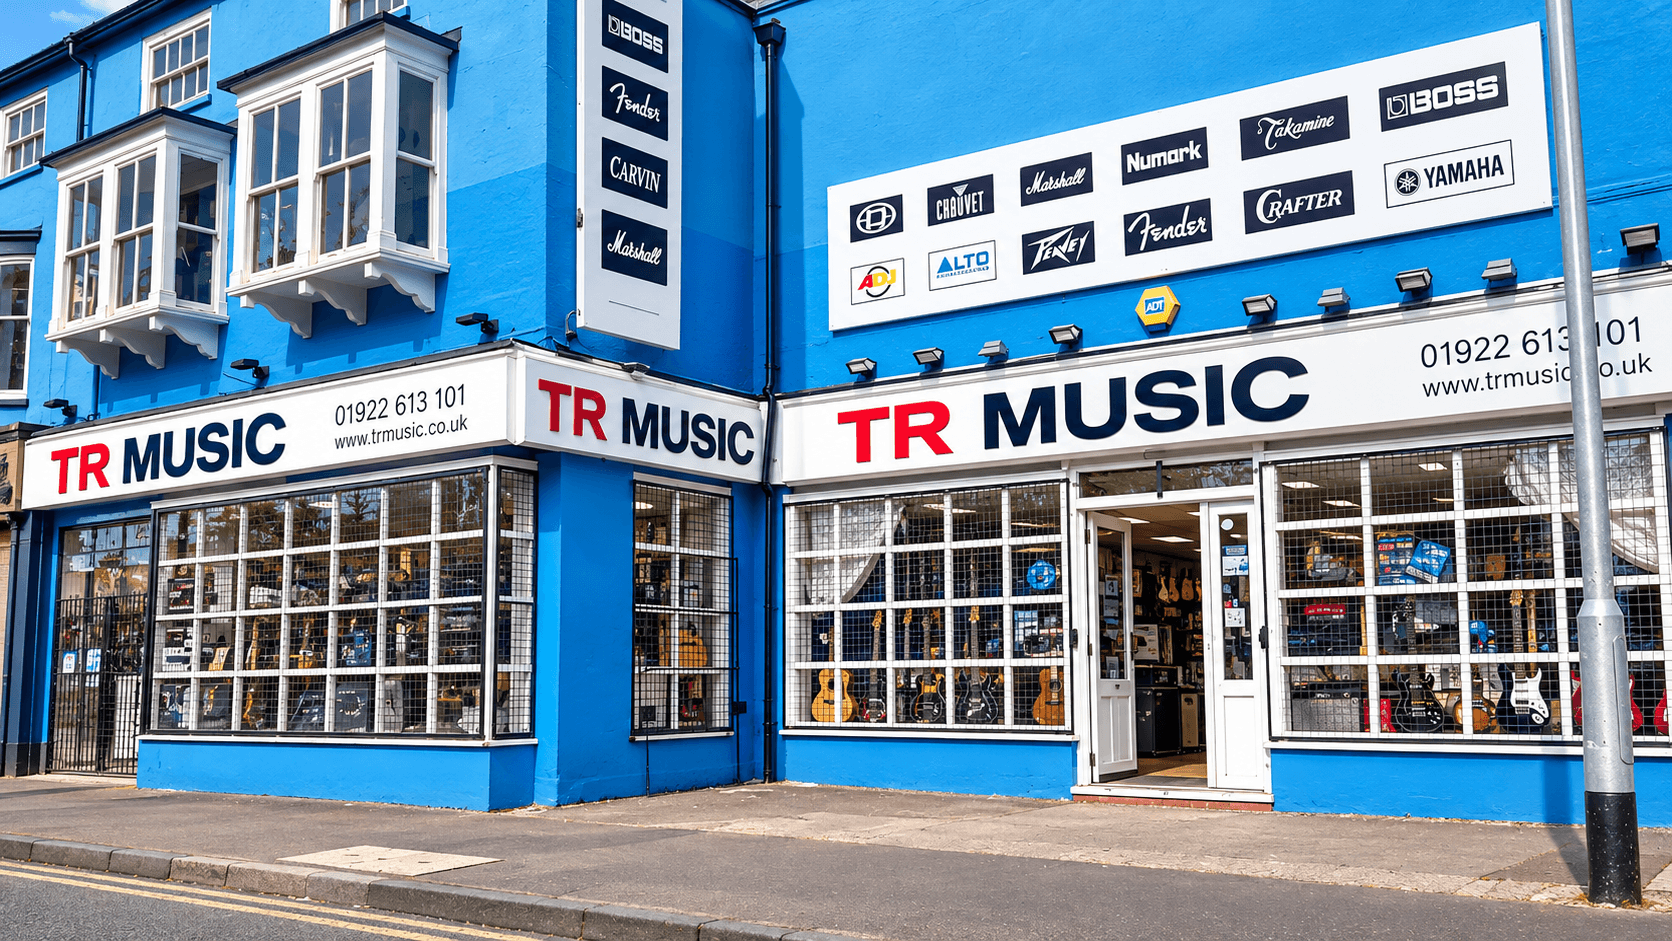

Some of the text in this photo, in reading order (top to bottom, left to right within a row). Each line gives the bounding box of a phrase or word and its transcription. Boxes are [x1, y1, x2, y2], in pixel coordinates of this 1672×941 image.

[620, 20, 663, 55] BOSS
[609, 82, 661, 123] Fender
[1409, 75, 1499, 115] BOSS
[1257, 115, 1335, 151] Takamine
[609, 155, 661, 193] CARVIN
[1126, 140, 1202, 173] Numark
[1423, 154, 1505, 189] YAMAHA
[1025, 167, 1087, 195] Marshall
[936, 190, 985, 221] CHAUVET
[1255, 188, 1343, 224] CRAFTER
[1127, 205, 1208, 251] Fender
[606, 229, 663, 266] Marshall
[936, 250, 990, 274] ALTO
[857, 268, 897, 291] ADJ
[1146, 299, 1164, 312] ADT
[1421, 334, 1511, 368] 01922
[335, 383, 465, 426] 01922 613 101
[537, 378, 755, 466] TR MUSIC
[837, 356, 1310, 464] TR MUSIC
[334, 414, 468, 450] www.trmusic.co.uk
[50, 412, 287, 495] TR MUSIC
